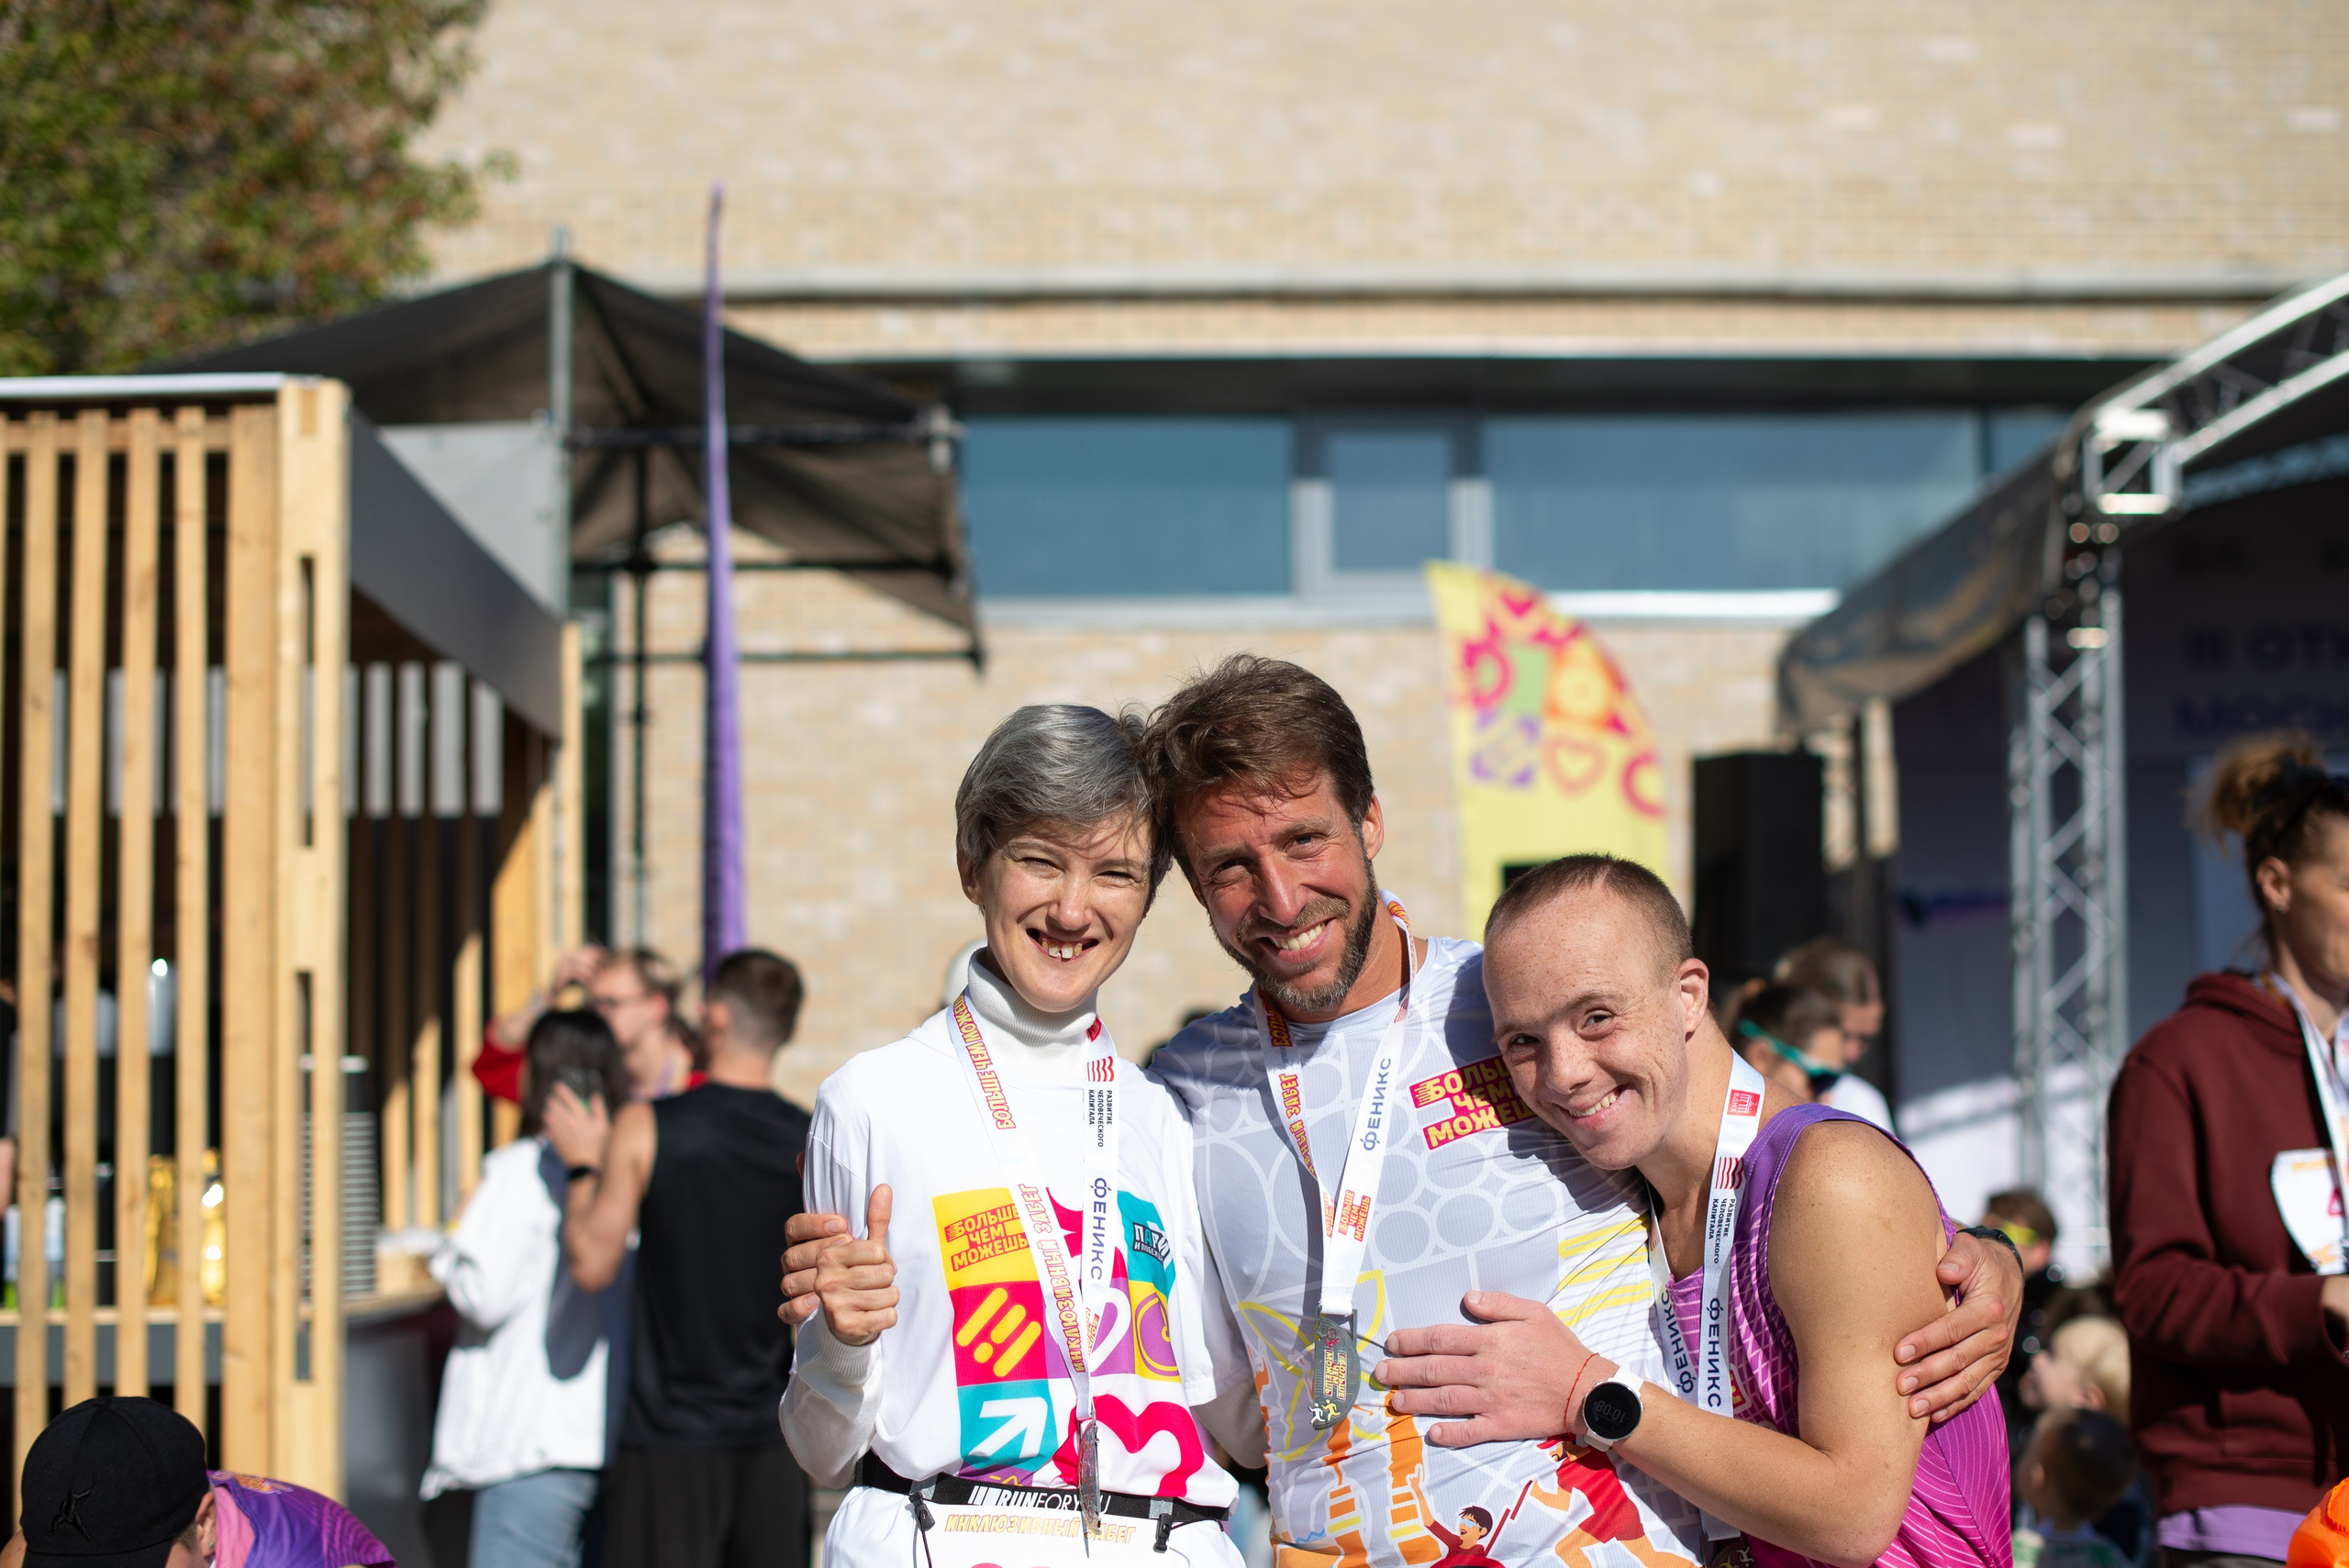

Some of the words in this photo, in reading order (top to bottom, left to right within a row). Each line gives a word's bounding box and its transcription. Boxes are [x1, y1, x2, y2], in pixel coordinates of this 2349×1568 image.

[953, 992, 983, 1043] МОЖЕШ
[965, 1040, 993, 1071] ЧЕМ
[976, 1070, 1017, 1129] БОЛЬШЕ
[1360, 1058, 1392, 1151] ФЕНИКС
[1414, 1059, 1512, 1106] БОЛЬ
[1453, 1080, 1513, 1111] ЧЕМ
[1731, 1092, 1741, 1113] ВДНХ
[1427, 1099, 1536, 1148] МОЖЕШ
[1019, 1184, 1052, 1234] ЗАБЕГ
[1089, 1177, 1112, 1280] ФЕНИКС
[1709, 1198, 1720, 1240] КАПИТАЛА
[1714, 1198, 1728, 1264] ЧЕЛОВЕЧЕСКОГО
[1722, 1198, 1736, 1237] РАЗВИТИЕ
[953, 1235, 1029, 1271] МОЖЕШЬ
[969, 1223, 1005, 1246] ЧЕМ
[1036, 1239, 1086, 1373] ИНКЛЮЗИВНЫЙ
[1661, 1289, 1697, 1394] ФЕНИКС
[1706, 1297, 1724, 1407] ФЕНИКС
[1597, 1400, 1626, 1423] 10:08
[996, 1490, 1111, 1514] RUNFORYU
[945, 1514, 1081, 1538] ИНКЛЮЗИВНЫЙ
